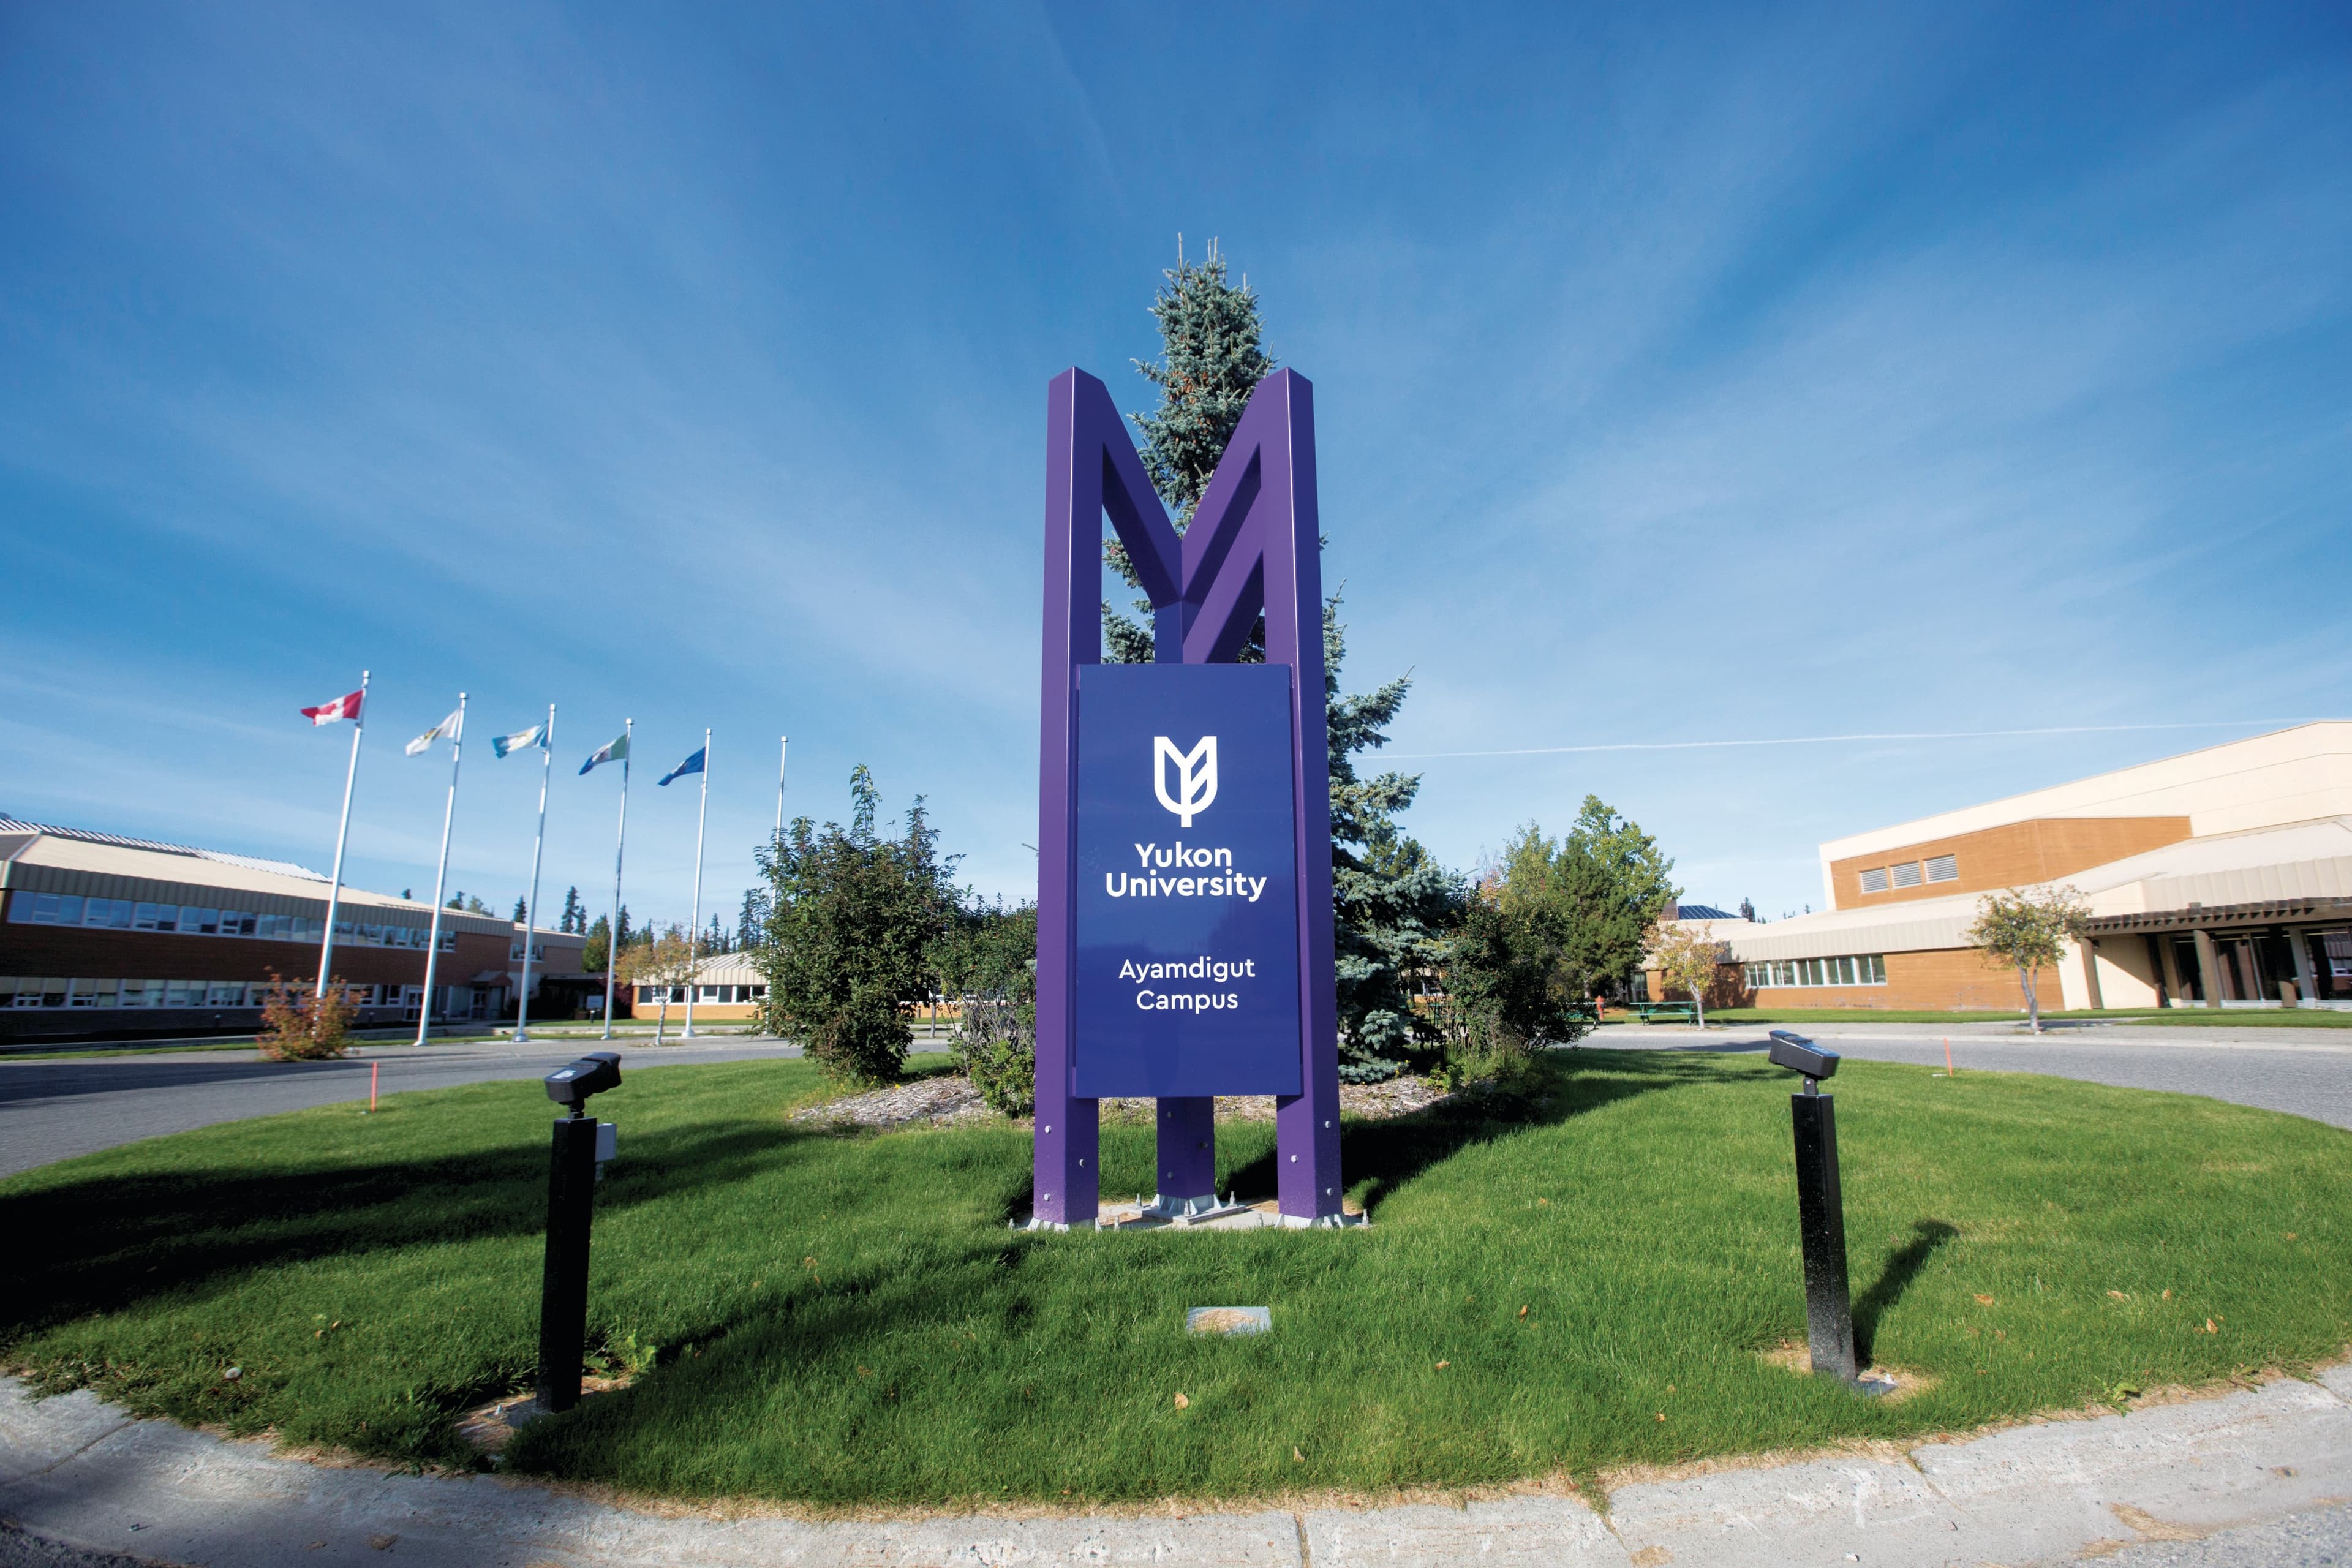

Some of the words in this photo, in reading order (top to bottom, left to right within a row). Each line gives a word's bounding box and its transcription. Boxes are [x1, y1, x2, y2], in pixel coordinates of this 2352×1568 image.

[1134, 841, 1232, 868] Yukon
[1106, 869, 1267, 902] University
[1118, 956, 1256, 984] Ayamdigut
[1136, 990, 1238, 1014] Campus
